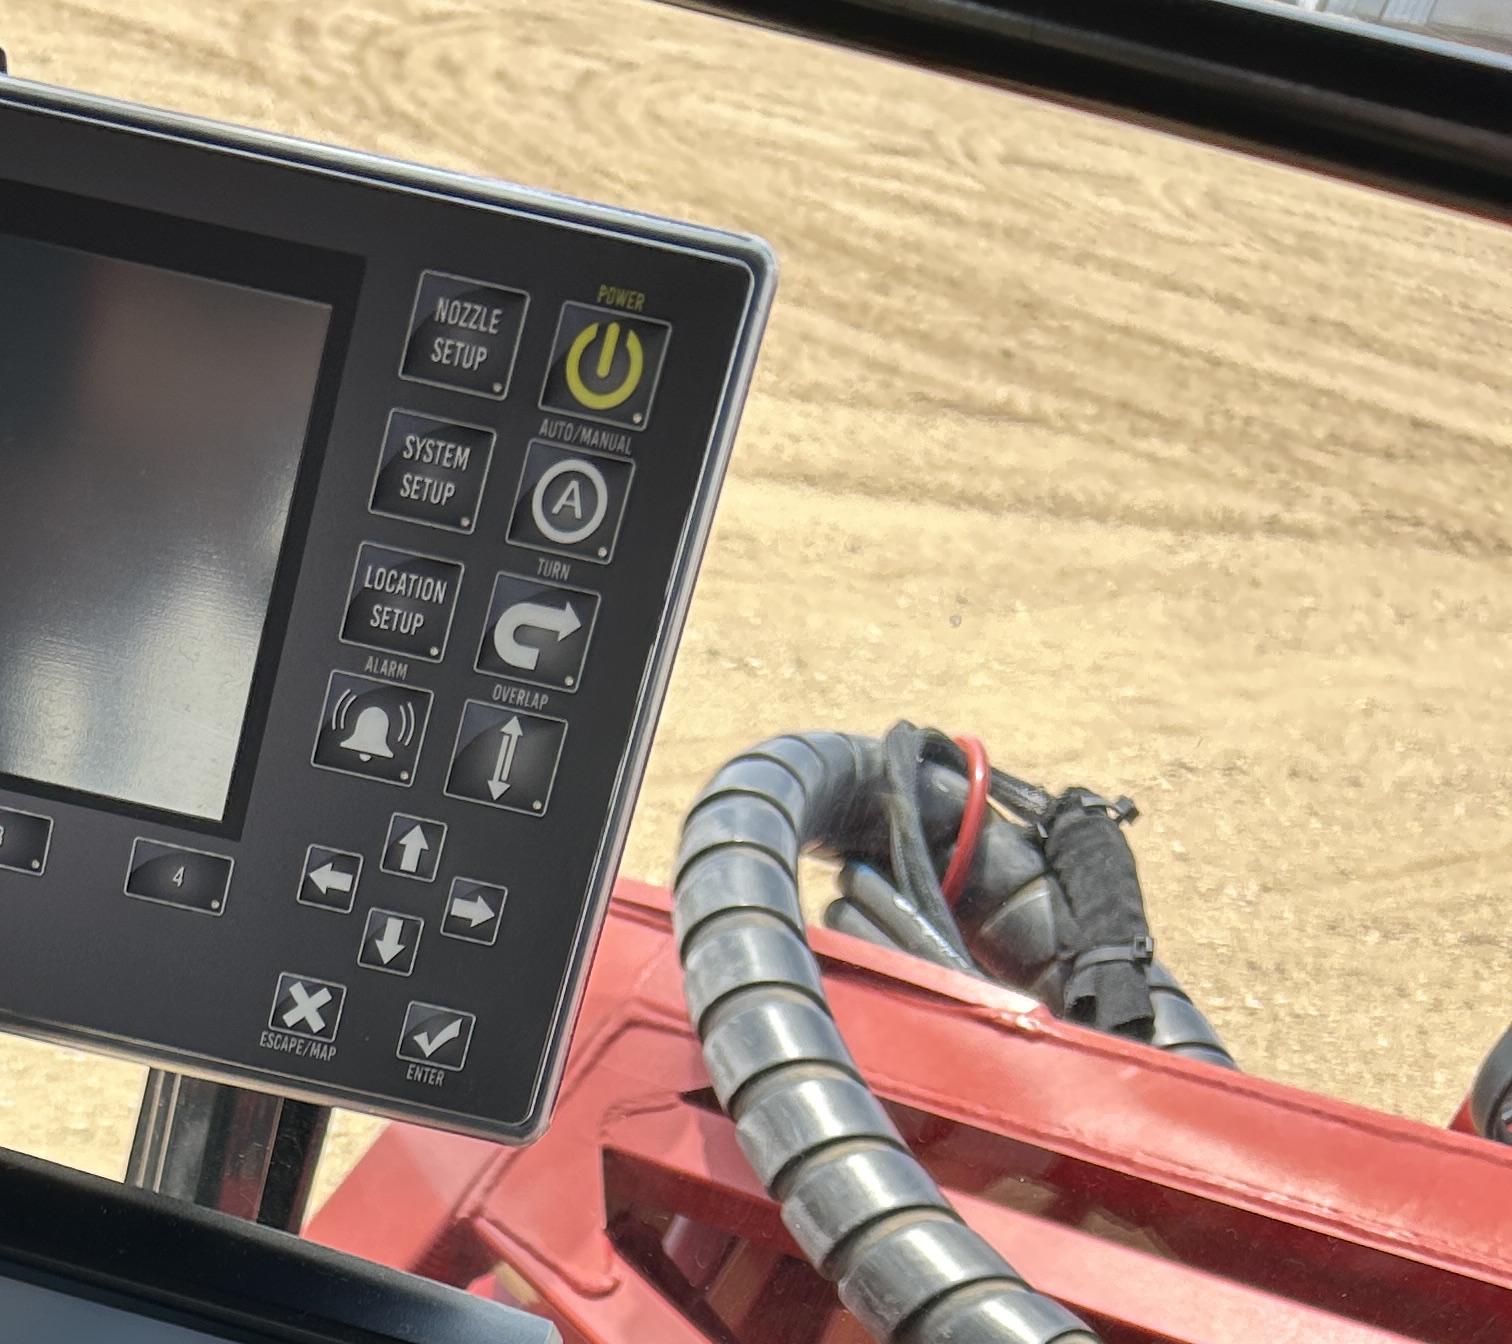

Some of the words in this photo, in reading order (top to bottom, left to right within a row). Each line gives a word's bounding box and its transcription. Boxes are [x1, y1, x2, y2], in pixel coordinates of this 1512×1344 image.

[597, 284, 646, 312] POWER
[433, 296, 503, 335] NOZZLE
[430, 338, 488, 371] SETUP
[402, 434, 472, 471] SYSTEM
[538, 418, 633, 455] AUTO/MANUAL
[399, 473, 456, 506] SETUP
[551, 480, 583, 520] A
[363, 564, 448, 605] LOCATION
[537, 558, 571, 581] TURN
[369, 604, 425, 637] SETUP
[365, 655, 408, 680] ALARM
[492, 684, 549, 712] OVERLAP
[172, 865, 185, 888] 4
[259, 1032, 337, 1063] ESCAPE/MAP
[406, 1065, 446, 1088] ENTER
